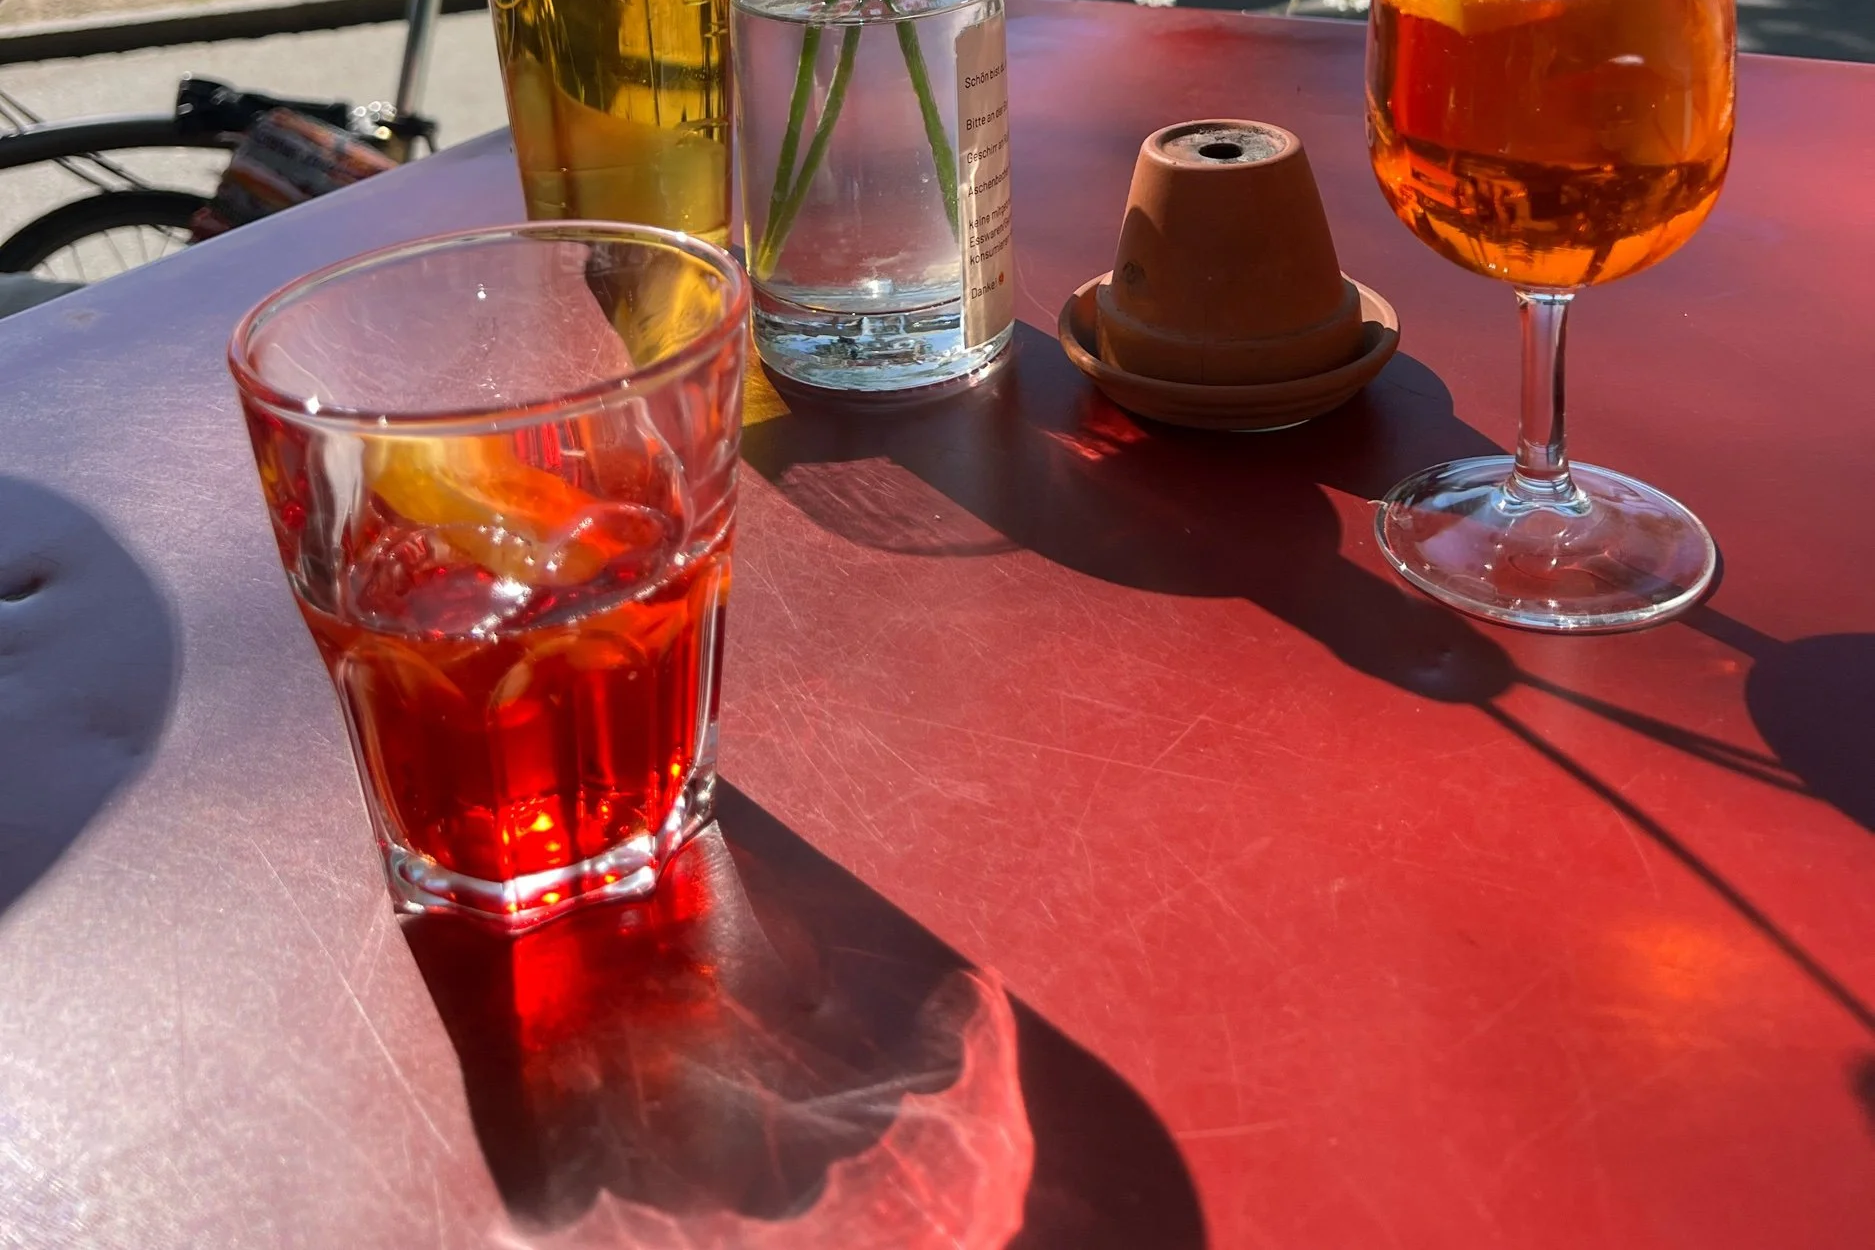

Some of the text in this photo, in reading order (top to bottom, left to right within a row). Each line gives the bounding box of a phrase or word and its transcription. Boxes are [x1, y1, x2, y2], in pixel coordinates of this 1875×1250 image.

[965, 71, 989, 89] Schön
[966, 116, 986, 131] Bitte
[969, 214, 991, 230] keine
